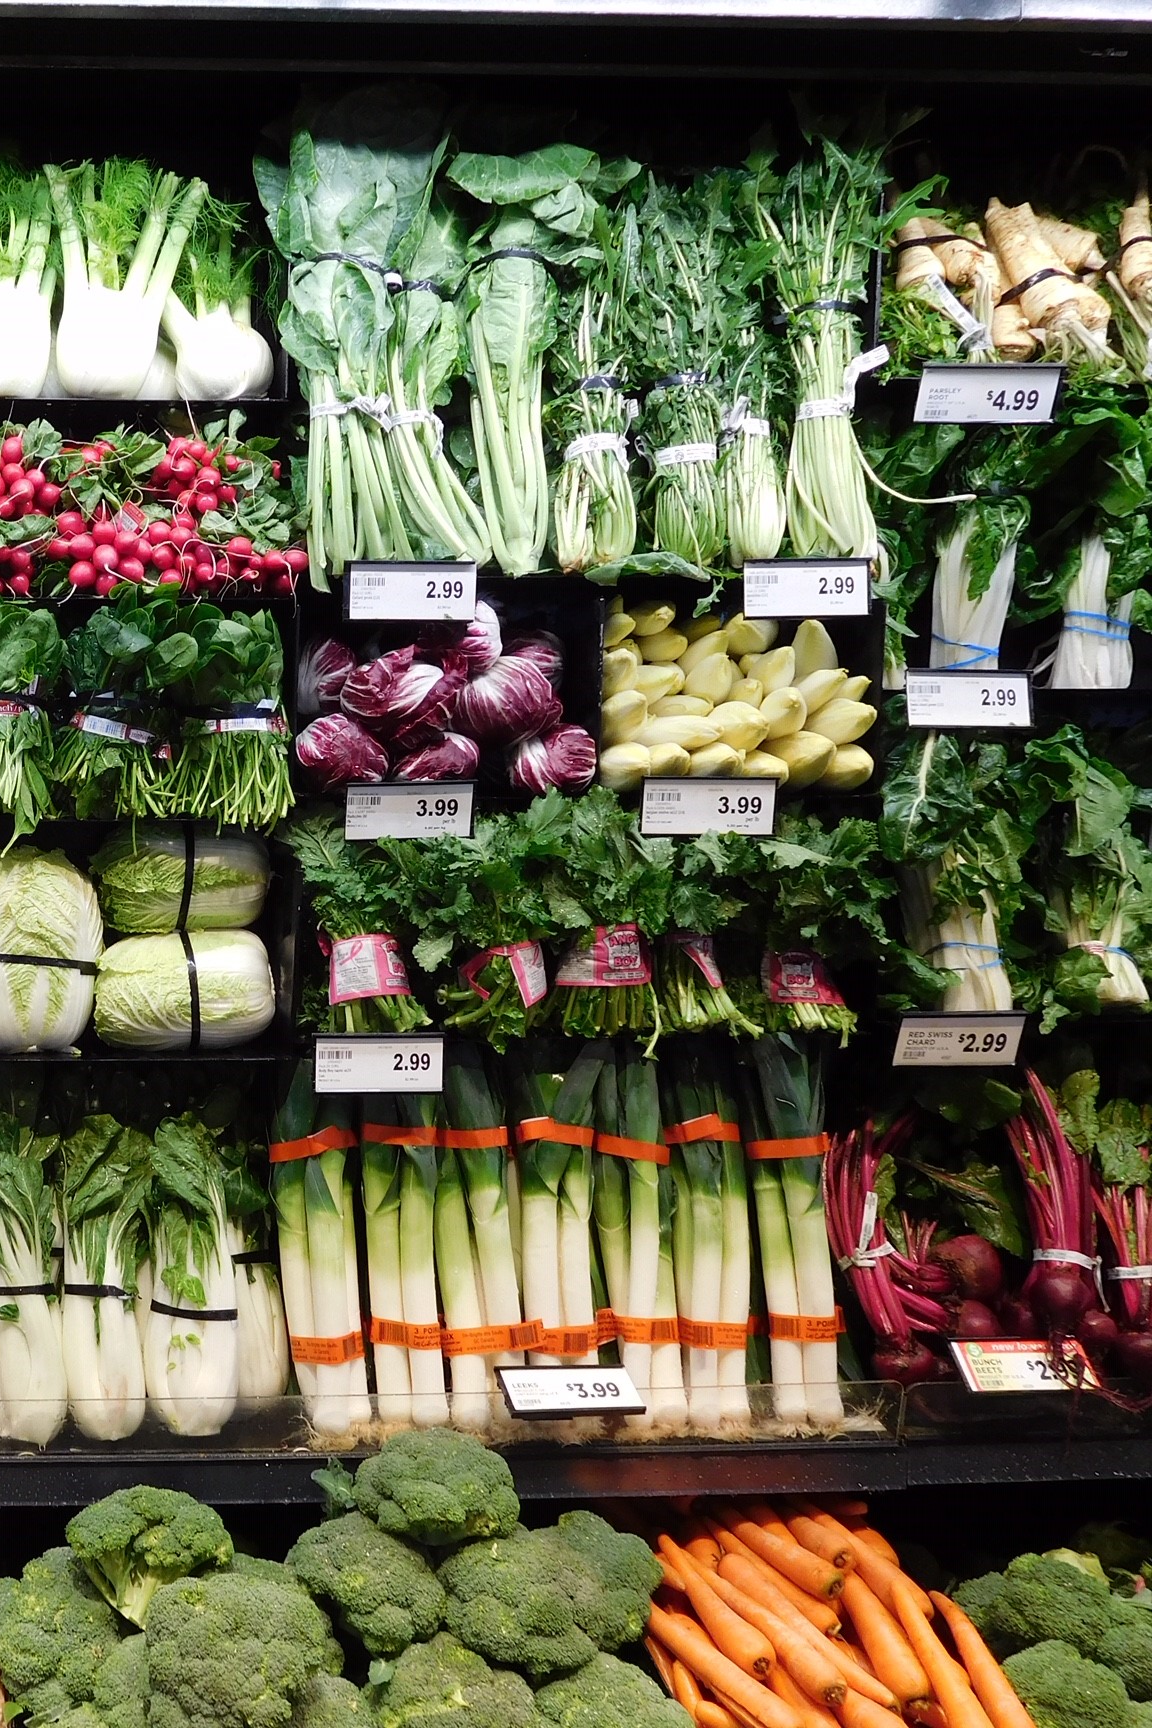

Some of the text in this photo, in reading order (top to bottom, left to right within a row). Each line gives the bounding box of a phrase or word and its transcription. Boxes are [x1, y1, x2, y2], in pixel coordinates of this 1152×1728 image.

[986, 389, 1039, 411] $4.99
[426, 580, 463, 599] 2.99
[818, 577, 855, 595] 2.99
[981, 689, 1017, 706] 2.99
[416, 798, 459, 817] 3.99
[717, 796, 762, 814] 3.99
[614, 955, 638, 967] BOY
[958, 1033, 1007, 1053] $2.99
[393, 1053, 431, 1071] 2.99
[991, 1343, 1015, 1351] new
[566, 1382, 620, 1398] $3.99
